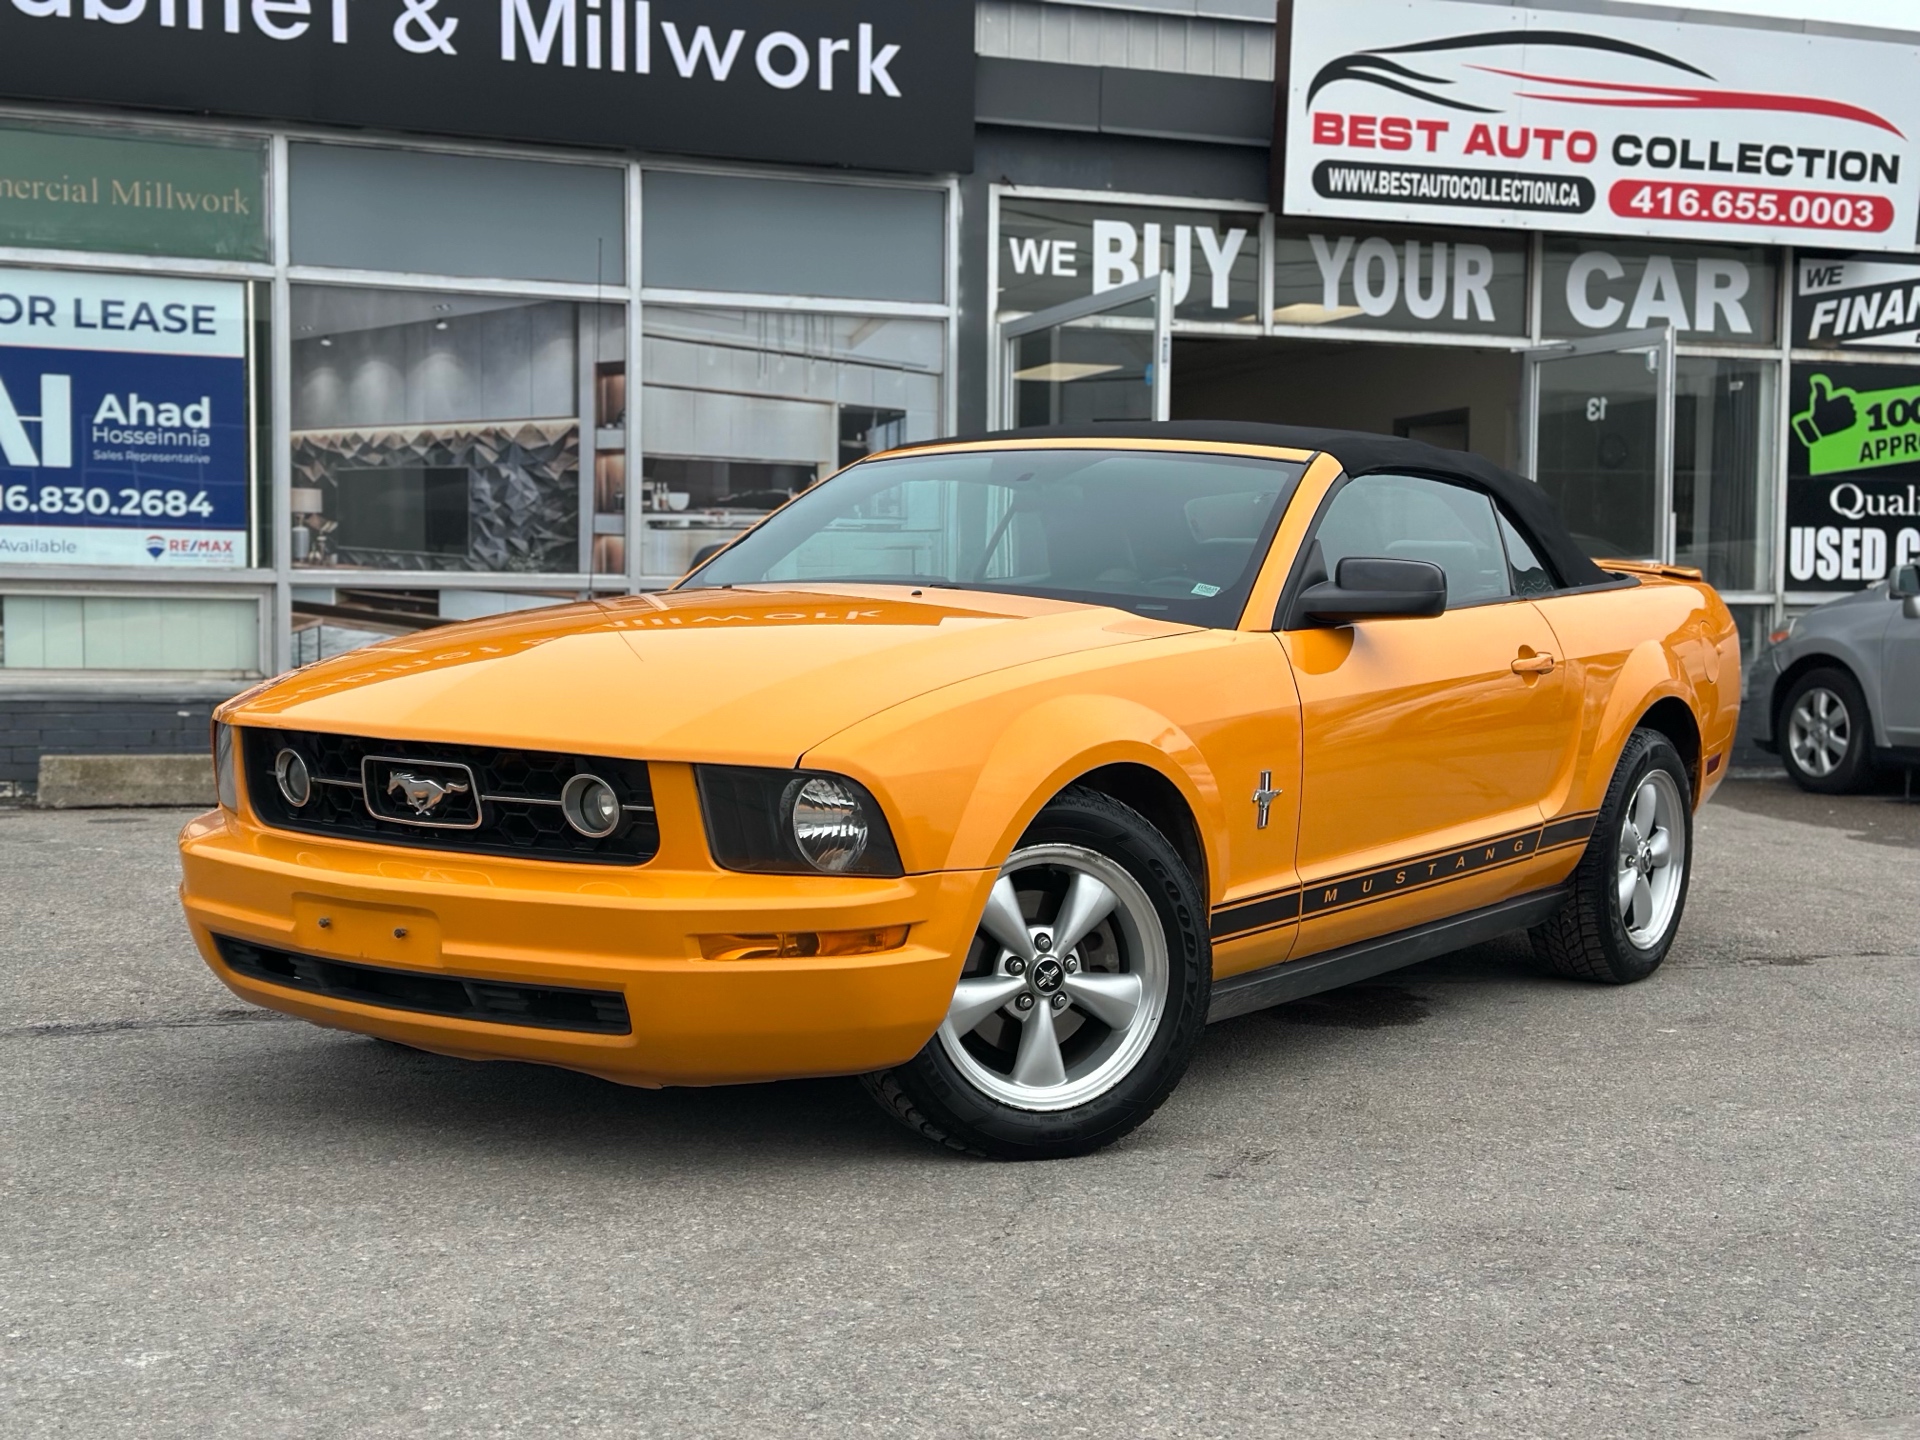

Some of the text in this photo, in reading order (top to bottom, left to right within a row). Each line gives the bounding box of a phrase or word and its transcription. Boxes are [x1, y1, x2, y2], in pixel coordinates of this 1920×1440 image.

[393, 0, 459, 55] &
[501, 0, 902, 97] Millwork
[1312, 112, 1900, 184] BEST AUTO COLLECTION
[111, 179, 250, 216] Millwork
[1328, 167, 1581, 207] WWW.BESTAUTOCOLLECTION.CA
[1630, 186, 1875, 228] 416.655.0003
[1009, 219, 1752, 334] WE BUY YOUR CAR
[1806, 265, 1845, 289] WE
[74, 298, 217, 336] LEASE
[93, 393, 211, 429] Ahad
[92, 426, 210, 447] Hosseinnia
[1859, 433, 1920, 464] APPR
[93, 450, 211, 464] Sales Representative
[0, 484, 214, 517] 6.830.2684
[169, 539, 234, 553] RE/MAX
[1789, 526, 1888, 582] USED
[1324, 839, 1524, 903] MUSTANG
